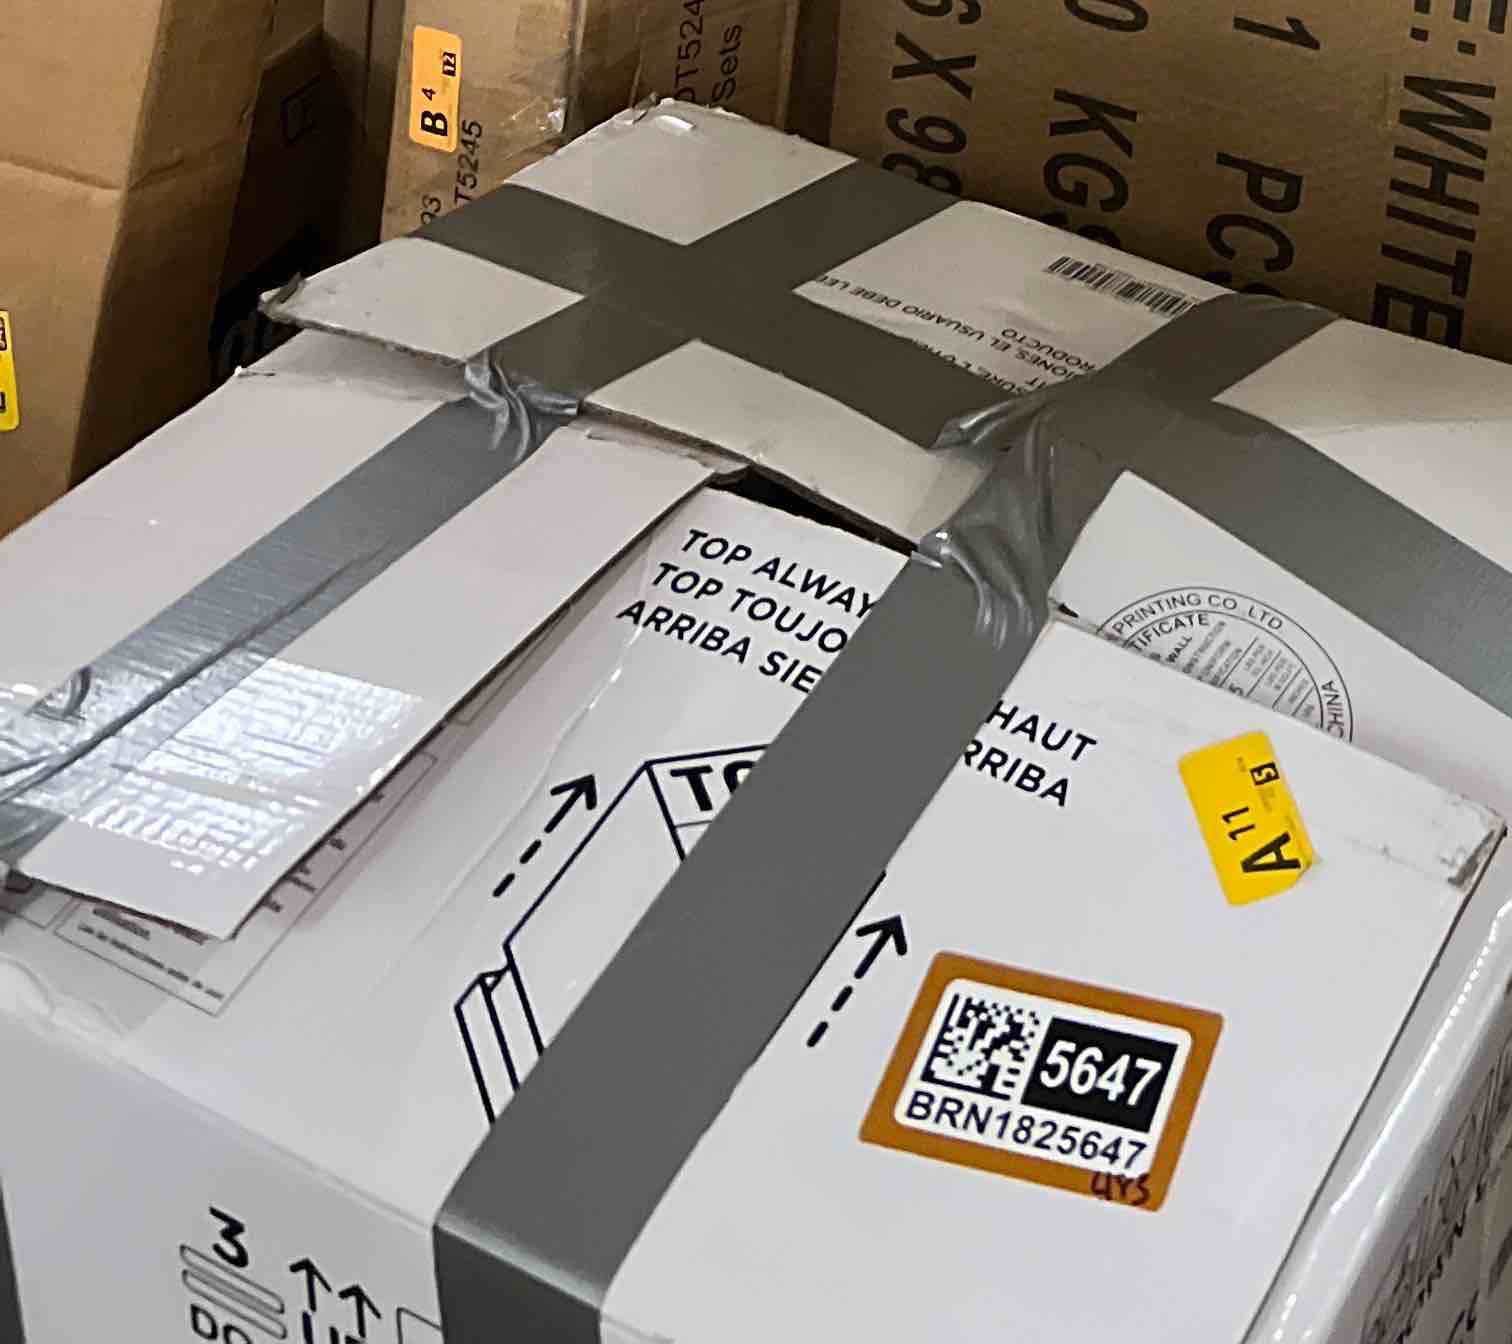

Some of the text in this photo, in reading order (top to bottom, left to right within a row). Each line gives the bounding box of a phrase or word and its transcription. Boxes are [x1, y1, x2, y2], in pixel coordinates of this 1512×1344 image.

[711, 24, 743, 103] Sets
[1233, 15, 1322, 53] 1
[420, 87, 449, 137] B 4
[1040, 86, 1142, 248] KG
[1201, 151, 1305, 298] PC
[1372, 74, 1498, 353] WHITE
[849, 285, 901, 309] DEBE
[902, 304, 986, 342] USUARIO
[682, 528, 753, 565] TOP
[652, 562, 849, 653] TOP TOUJO
[1111, 593, 1283, 636] PRINTING CO LTD
[616, 600, 824, 694] ARRIBA SIE
[983, 700, 1098, 761] HAUT
[1320, 680, 1345, 739] CHINA
[1221, 806, 1302, 873] A 11
[1039, 1038, 1163, 1107] 5647
[904, 1089, 1149, 1171] BRN1825647
[208, 1206, 249, 1268] 3
